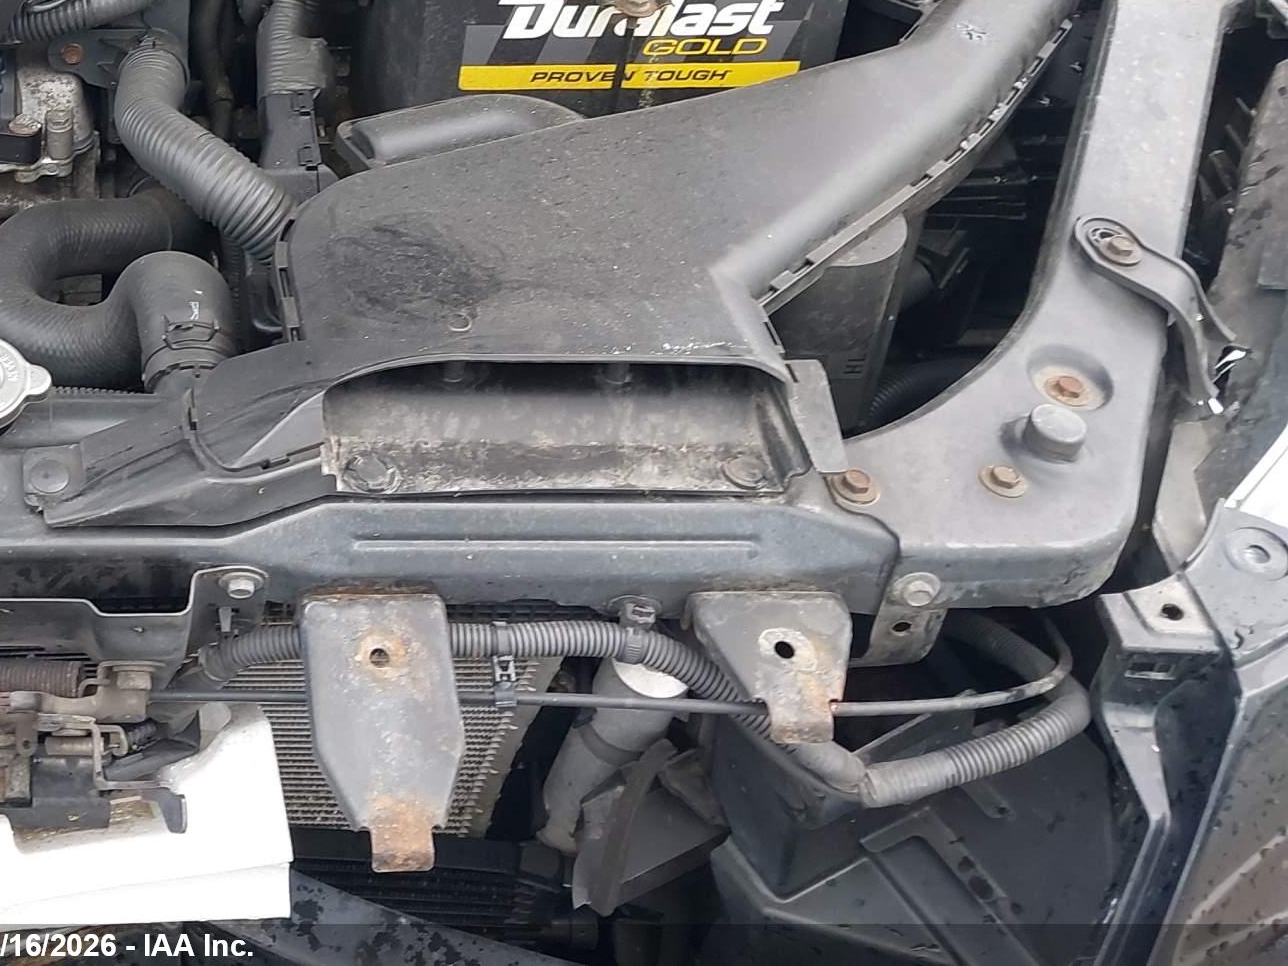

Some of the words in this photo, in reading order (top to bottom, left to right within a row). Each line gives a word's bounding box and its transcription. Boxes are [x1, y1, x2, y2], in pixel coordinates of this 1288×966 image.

[642, 37, 767, 56] GOLD
[530, 69, 635, 83] PROVEN
[643, 69, 730, 82] TOUGH
